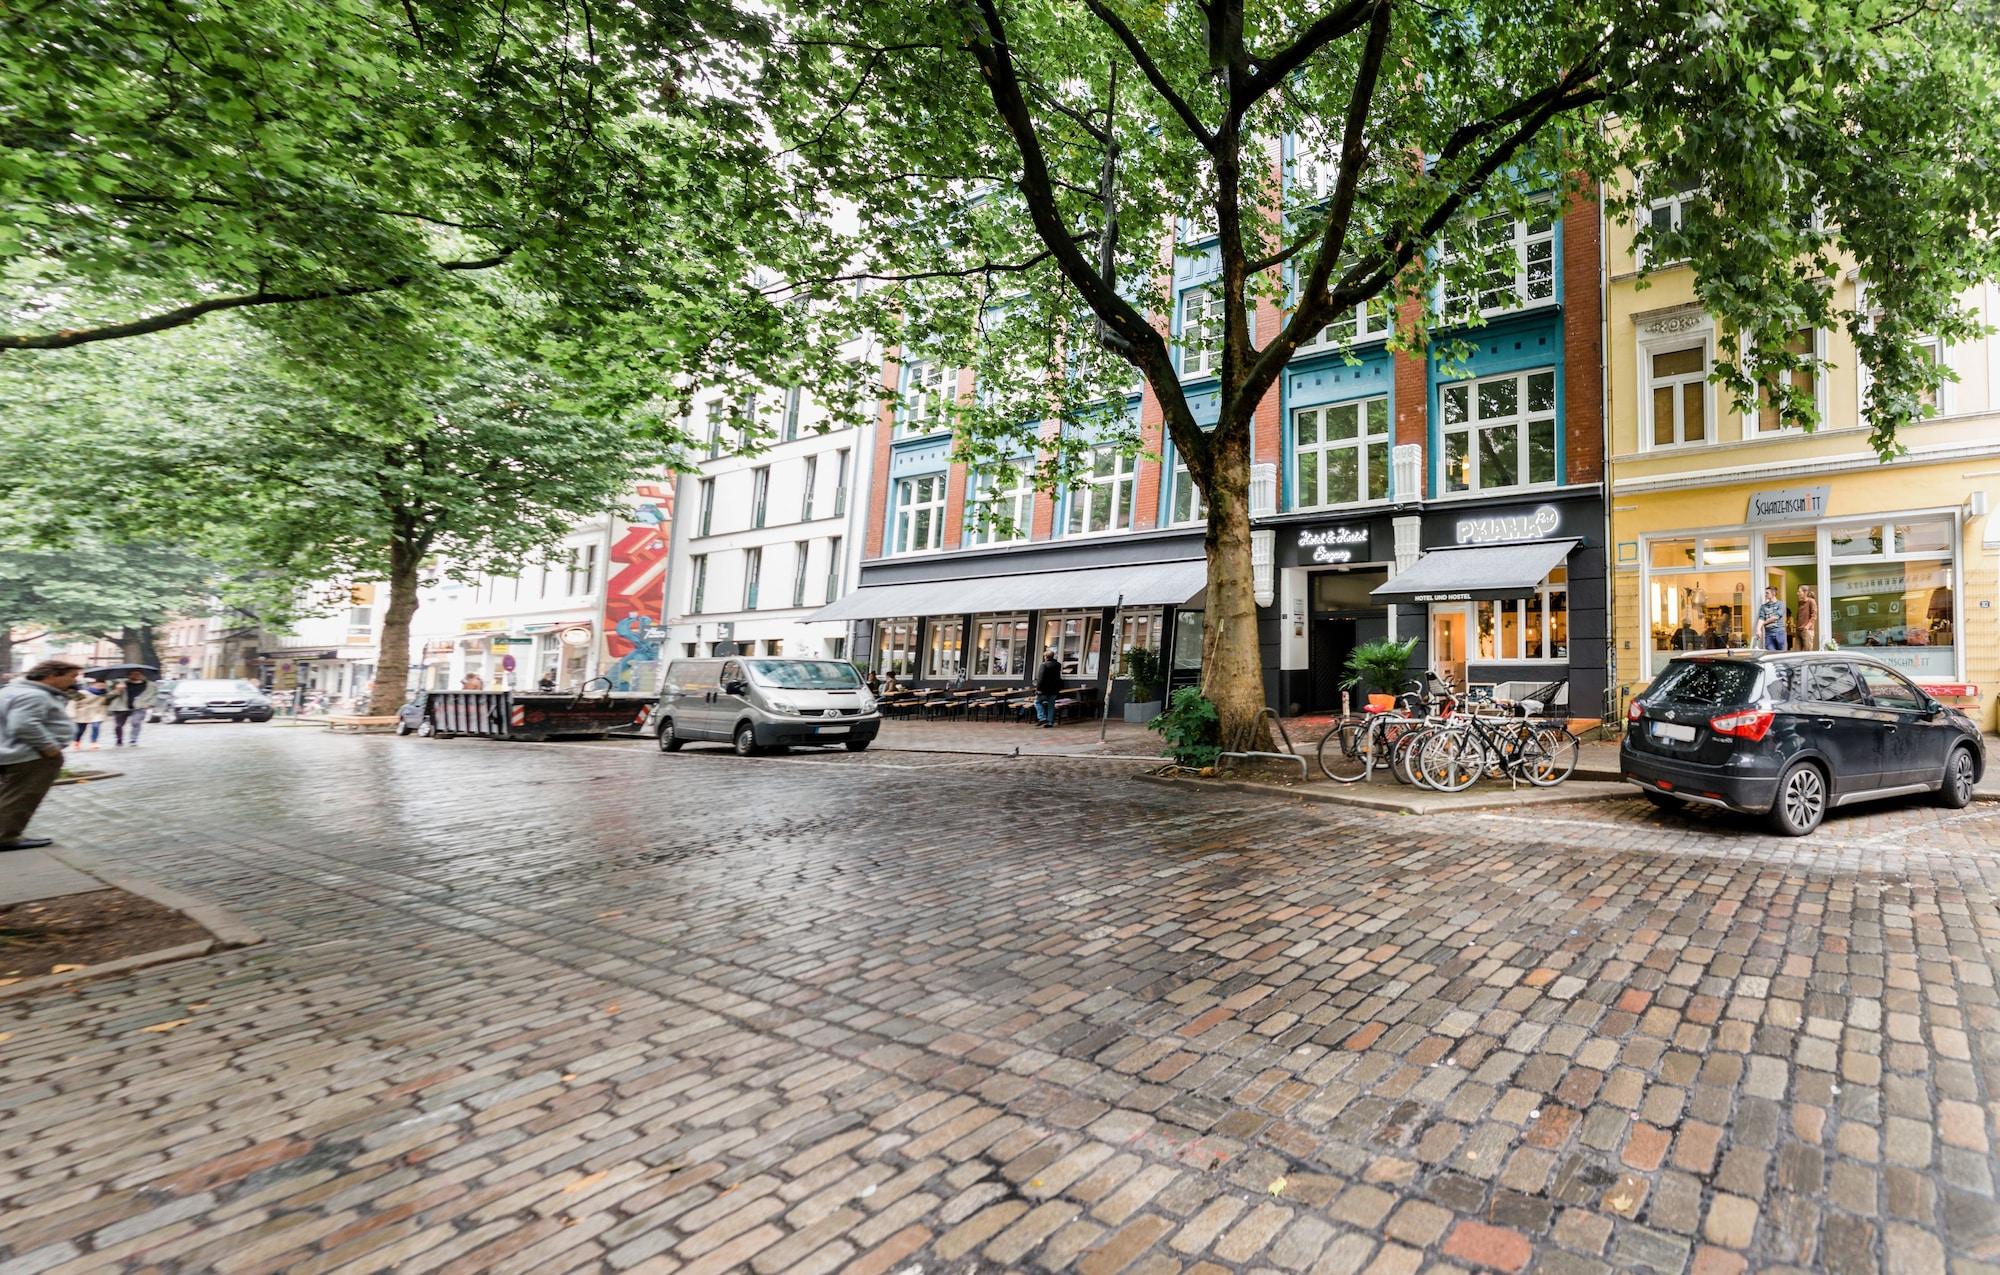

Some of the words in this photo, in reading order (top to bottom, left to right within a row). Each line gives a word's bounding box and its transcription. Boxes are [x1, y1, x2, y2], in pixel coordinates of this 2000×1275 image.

[1298, 530, 1326, 546] Hotel
[1327, 530, 1336, 543] &
[1336, 527, 1368, 544] Hostel
[1313, 545, 1351, 563] Eingang
